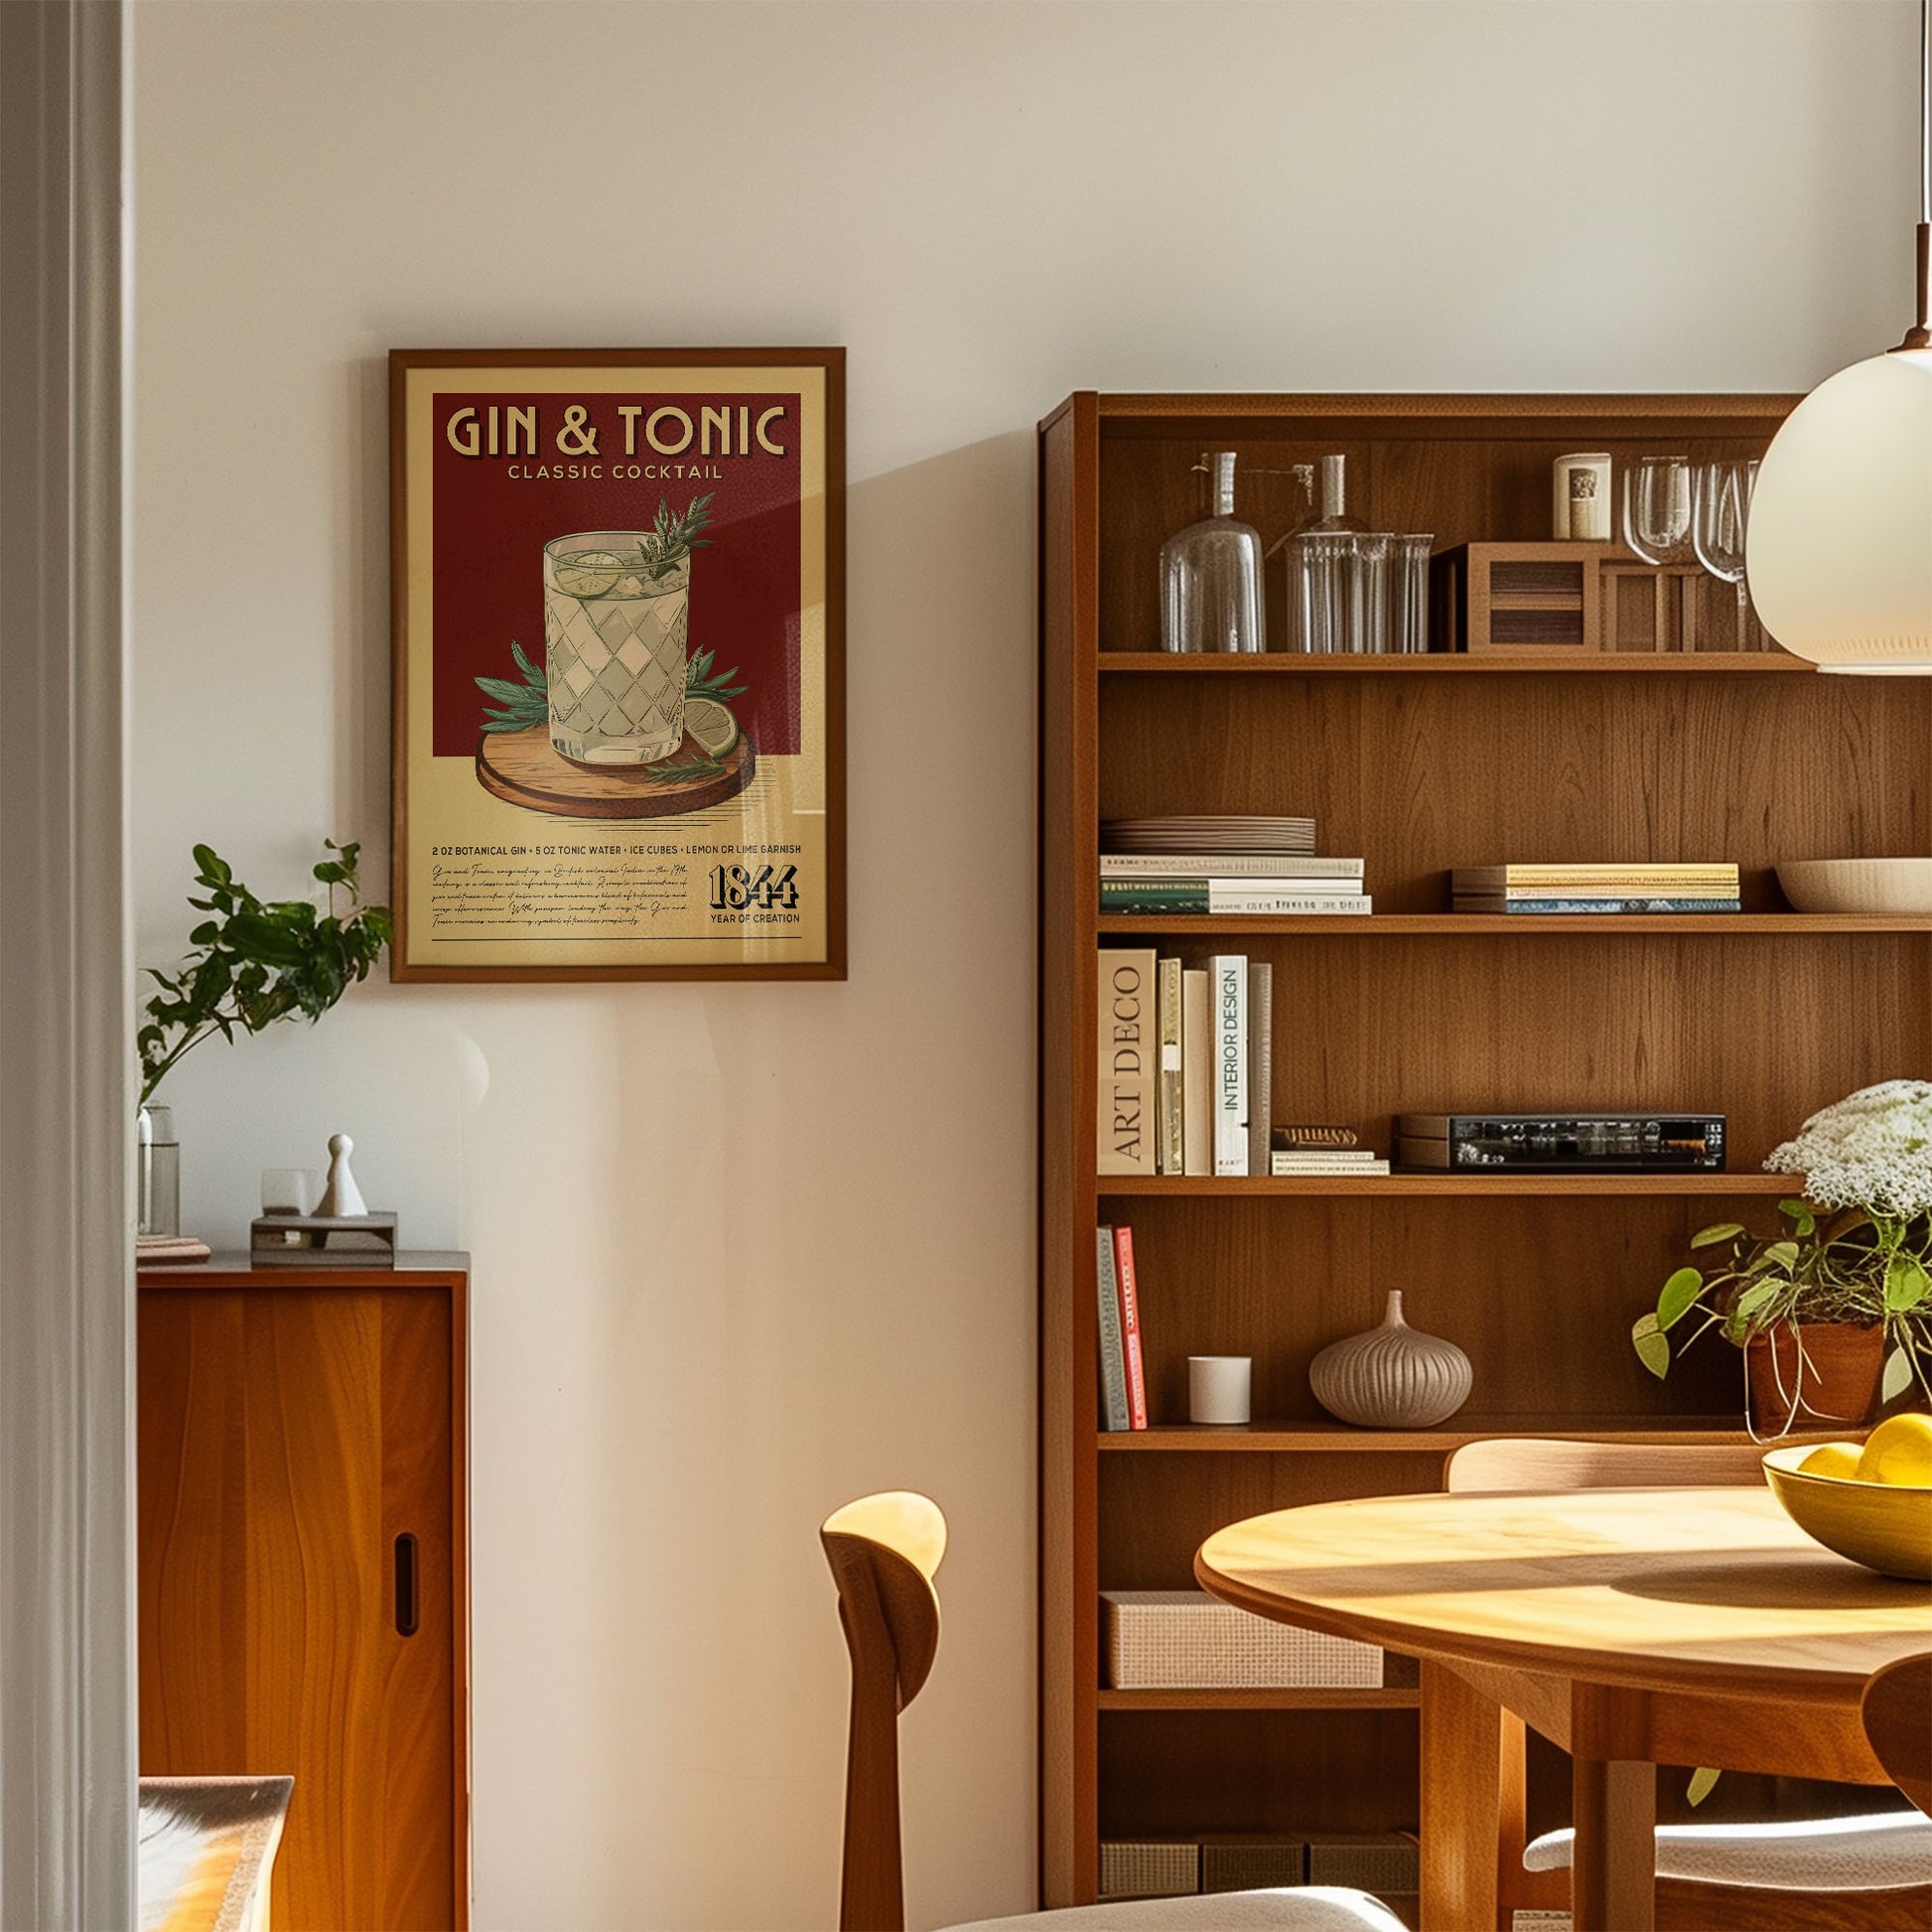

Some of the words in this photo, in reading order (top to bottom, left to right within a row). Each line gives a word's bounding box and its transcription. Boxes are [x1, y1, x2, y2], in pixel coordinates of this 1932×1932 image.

[447, 405, 539, 459] GIN
[555, 405, 602, 459] &
[618, 405, 787, 459] TONIC
[507, 465, 603, 480] CLASSIC
[612, 465, 723, 480] COCKTAIL
[432, 847, 439, 856] 2
[441, 846, 453, 856] OZ
[455, 846, 508, 856] BOTANICAL
[510, 846, 526, 855] GIN
[535, 846, 541, 855] 5
[543, 846, 556, 855] OZ
[558, 846, 587, 855] TONIC
[589, 845, 621, 855] WATER
[629, 845, 644, 855] ICE
[646, 845, 678, 855] CUBES
[686, 845, 718, 854] LEMON
[721, 845, 735, 854] OR
[736, 845, 758, 854] LIME
[760, 844, 801, 854] GARNISH
[708, 864, 800, 910] 1844
[710, 913, 736, 923] YEAR
[738, 913, 752, 923] OF
[753, 913, 800, 923] CREATION
[1112, 966, 1142, 1076] DECO
[1223, 969, 1237, 1030] DESIGN
[1224, 1034, 1238, 1110] INTERIOR
[1113, 1086, 1142, 1163] ART
